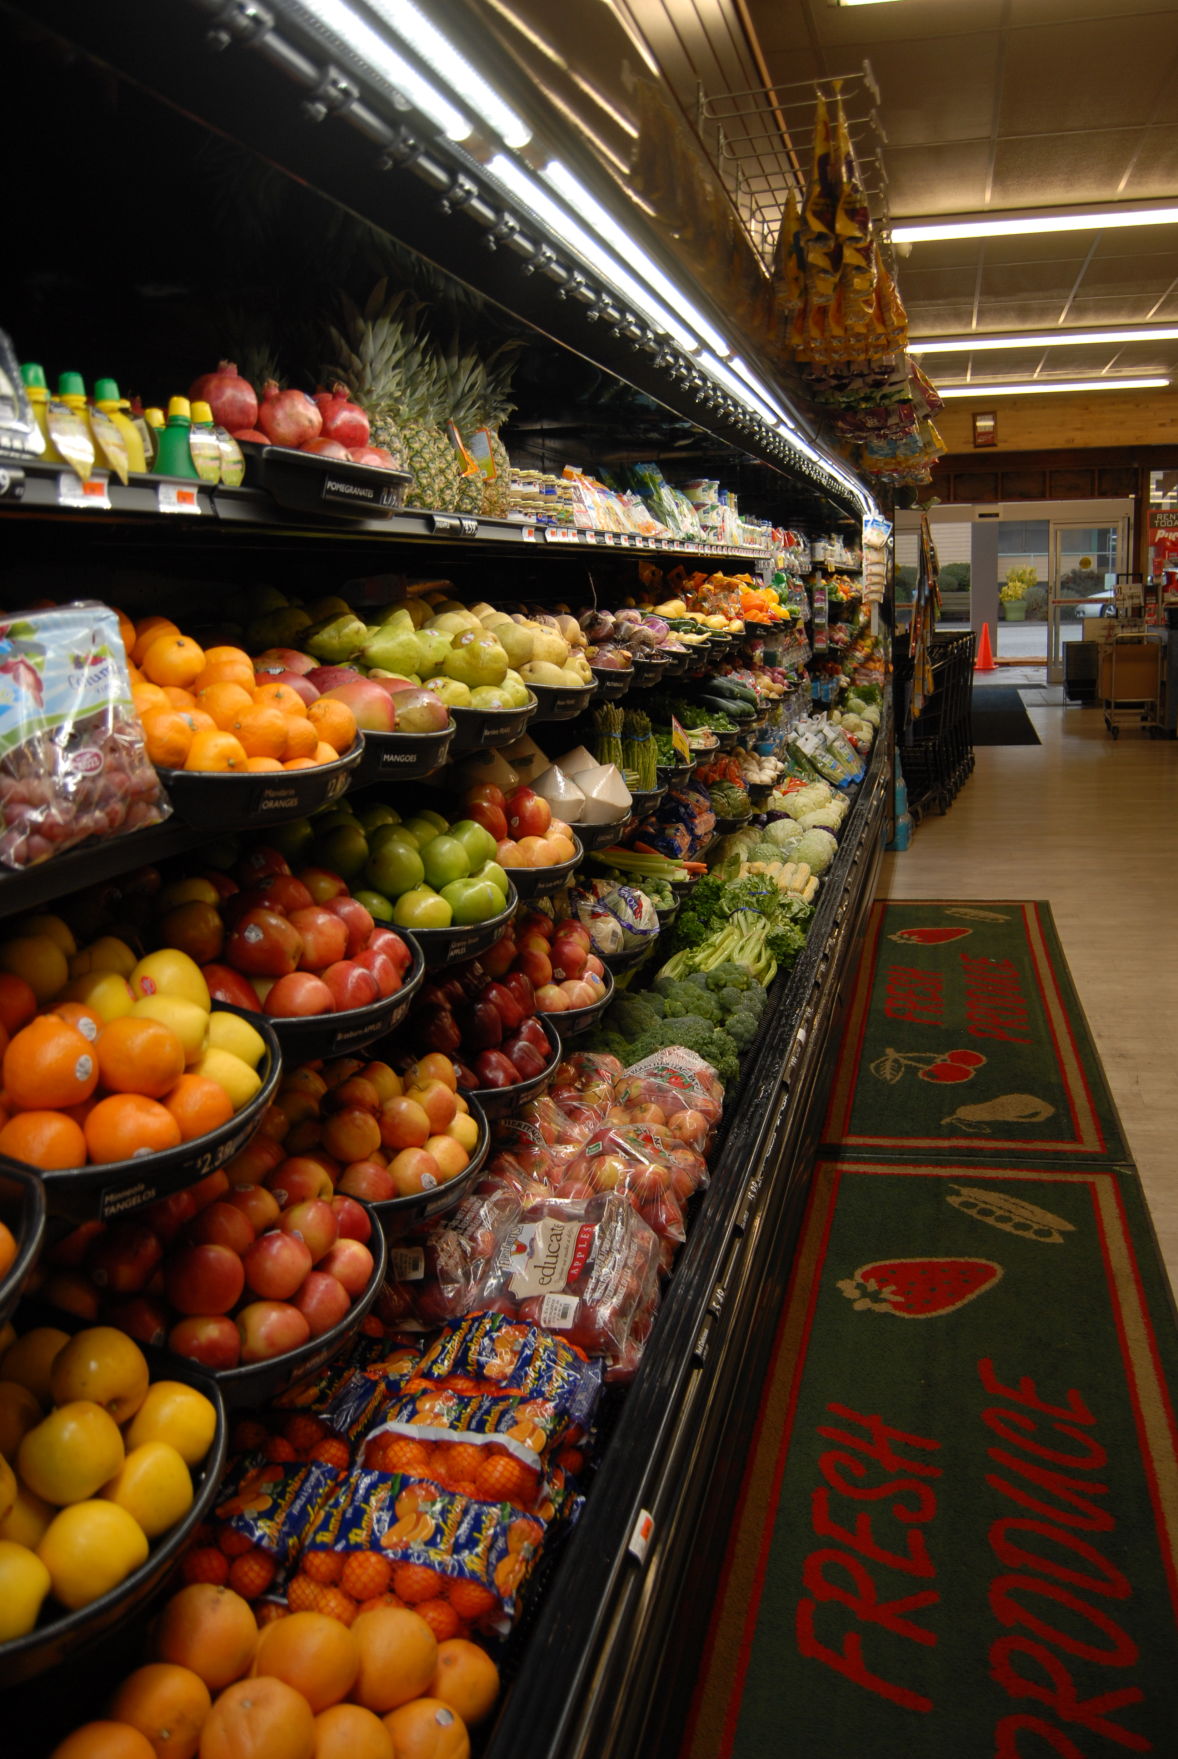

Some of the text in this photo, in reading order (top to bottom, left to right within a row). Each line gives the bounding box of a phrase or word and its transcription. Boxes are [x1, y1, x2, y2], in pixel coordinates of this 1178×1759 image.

[327, 480, 375, 498] POMEGRANATES
[1156, 513, 1178, 521] REN
[384, 753, 417, 763] MANGOES
[262, 798, 299, 810] ORANGES
[882, 965, 945, 1025] FRESH
[960, 953, 1035, 1045] PRODUCE
[104, 1188, 157, 1217] TANGELOS
[534, 1223, 565, 1286] educate
[571, 1225, 593, 1276] APPLES
[796, 1402, 943, 1714] FRESH
